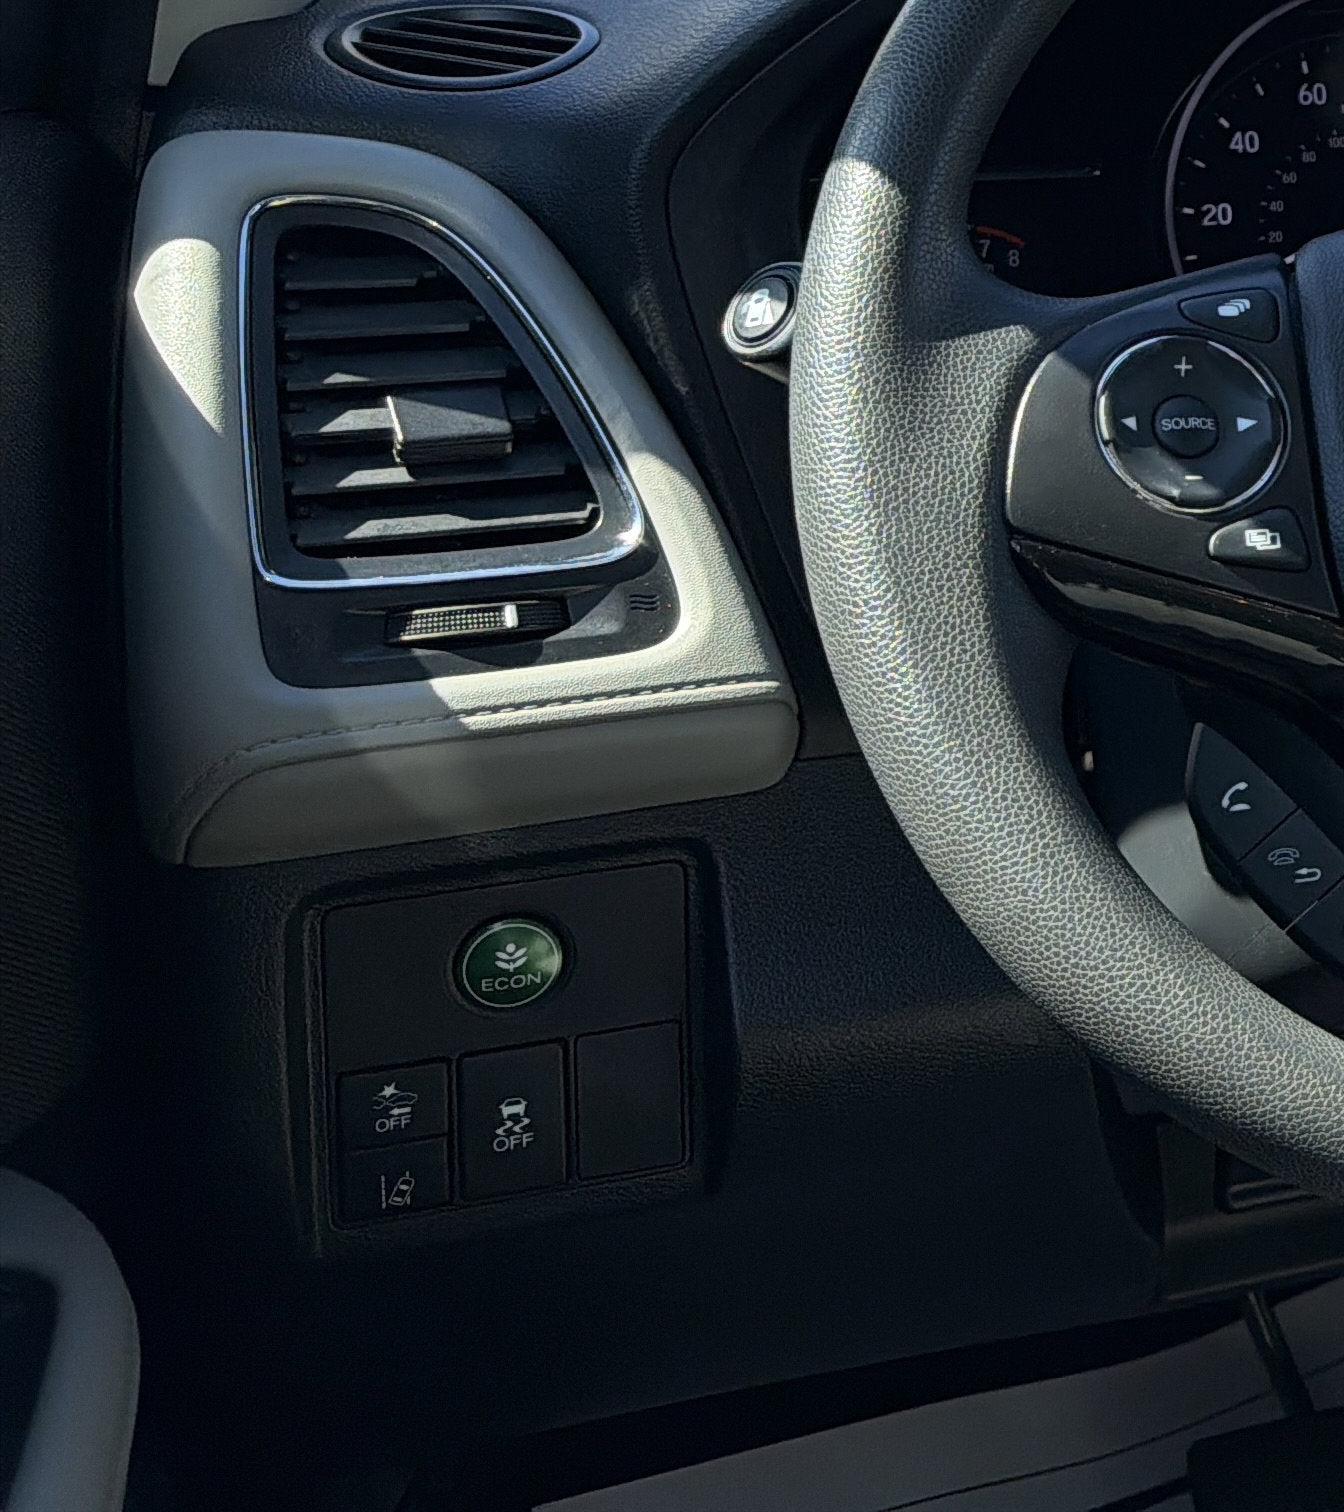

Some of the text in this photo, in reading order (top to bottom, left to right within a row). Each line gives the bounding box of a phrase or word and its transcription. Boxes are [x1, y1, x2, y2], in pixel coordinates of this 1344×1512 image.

[1298, 83, 1327, 105] 60
[1229, 131, 1260, 154] 40
[1302, 151, 1317, 163] 80
[1282, 171, 1298, 184] 60
[1201, 202, 1233, 226] 20
[1269, 200, 1284, 212] 40
[1268, 230, 1284, 243] 20
[978, 239, 991, 258] 7
[1008, 249, 1020, 267] 8
[1161, 416, 1217, 431] SOURCE
[481, 970, 543, 993] ECON
[375, 1113, 413, 1134] OFF
[492, 1131, 535, 1153] OFF
